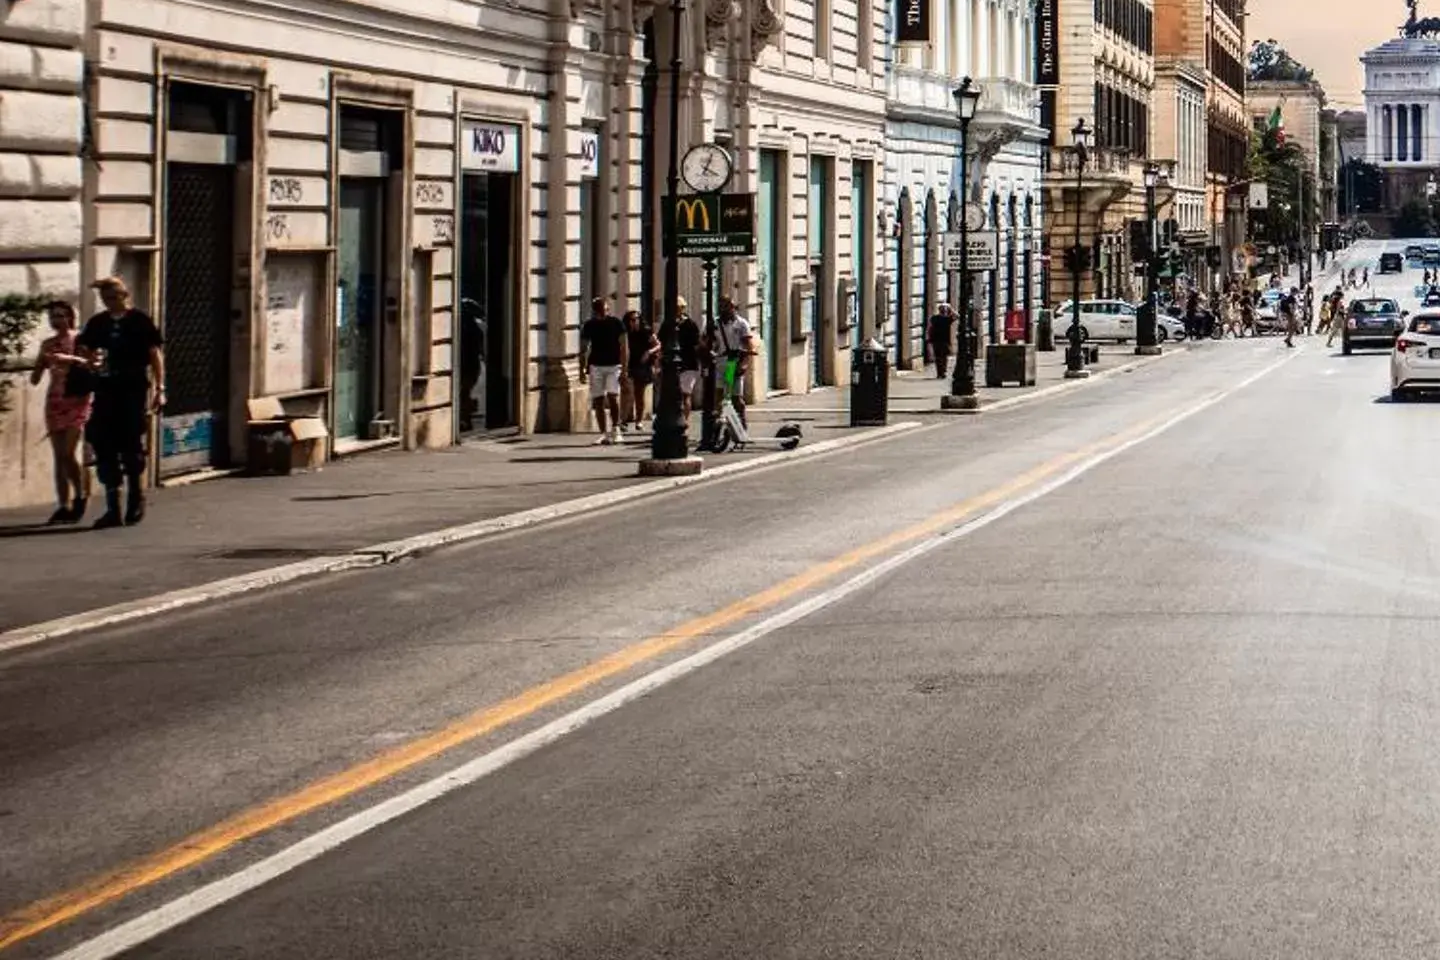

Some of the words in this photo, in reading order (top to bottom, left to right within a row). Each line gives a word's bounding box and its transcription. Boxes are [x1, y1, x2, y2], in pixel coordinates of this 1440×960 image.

[1042, 20, 1052, 50] Glam
[1042, 53, 1053, 75] The
[472, 127, 505, 155] KIKO
